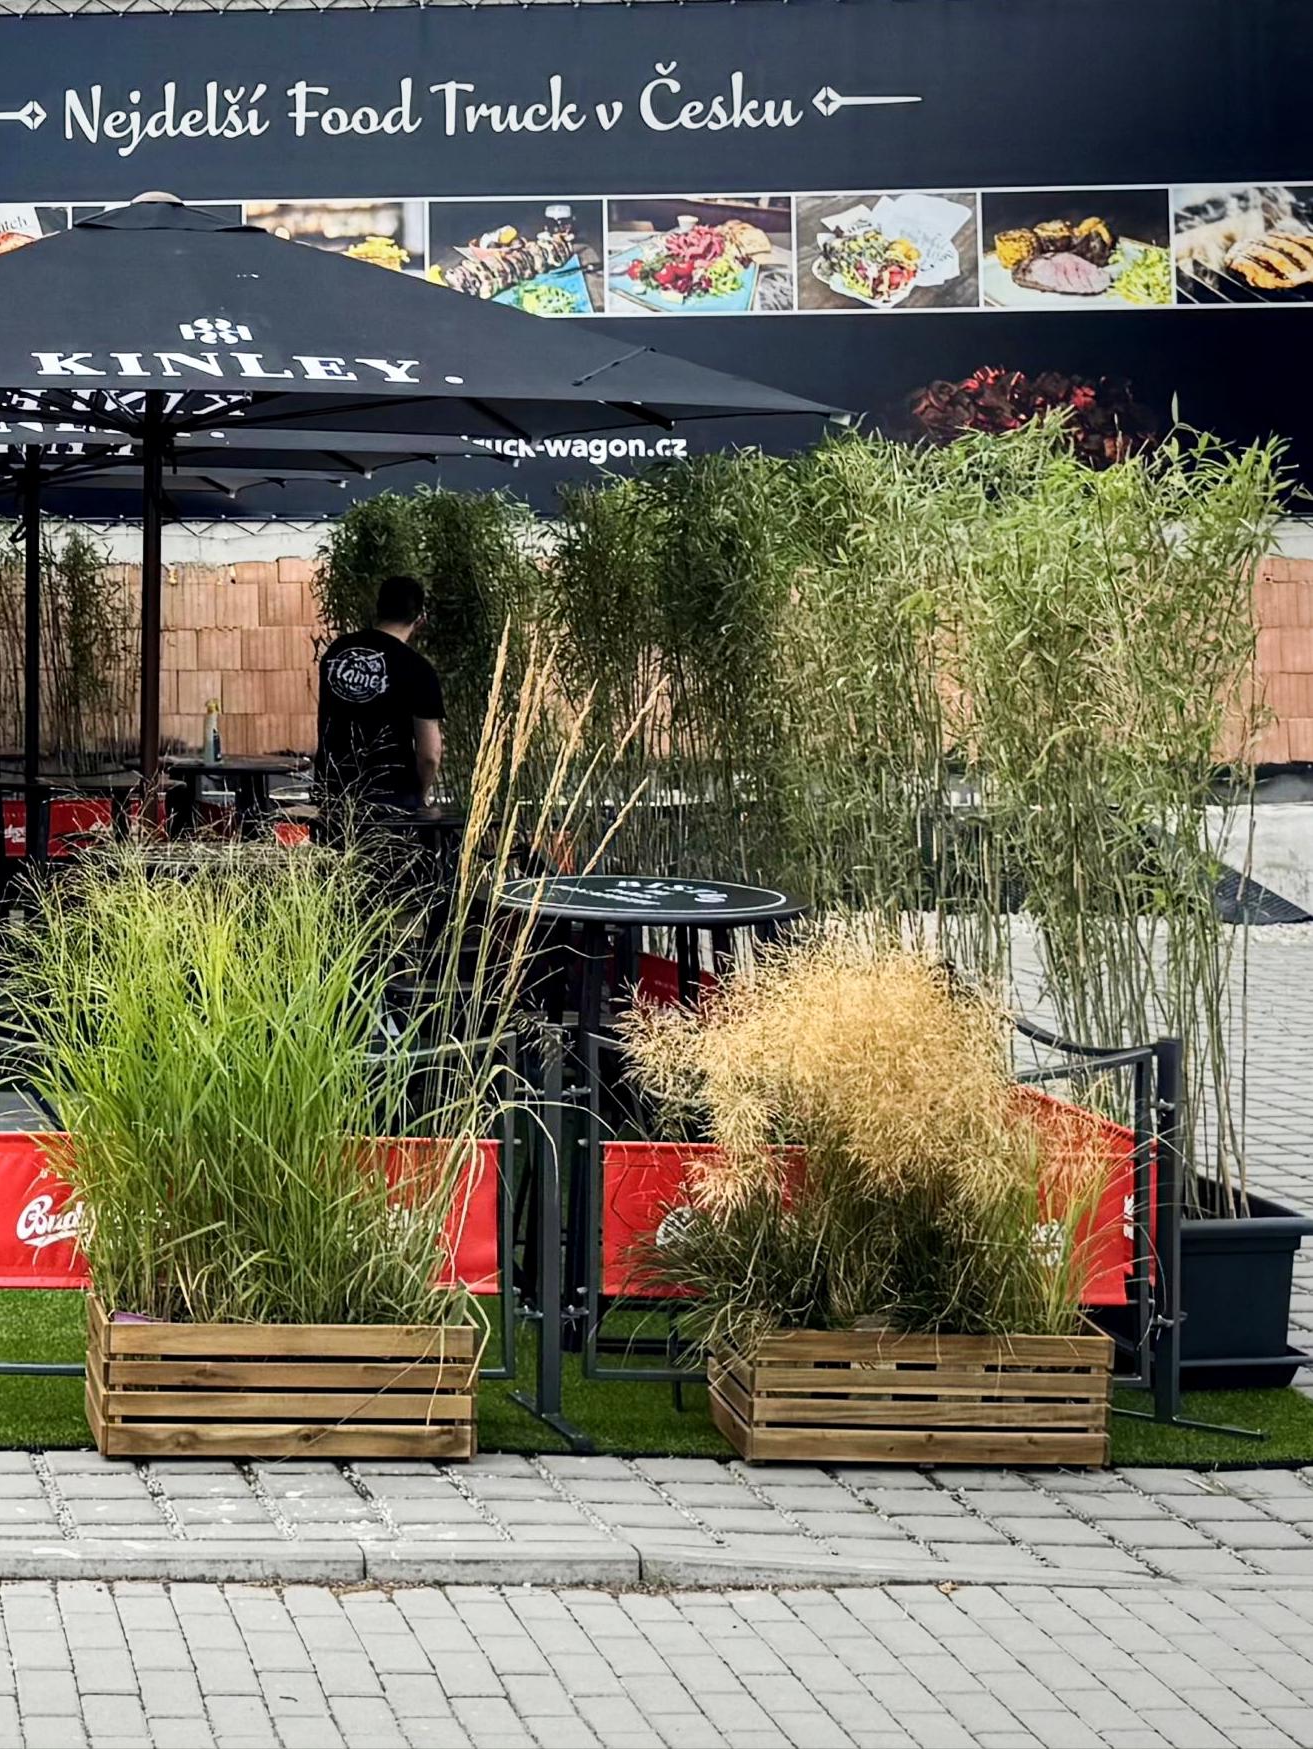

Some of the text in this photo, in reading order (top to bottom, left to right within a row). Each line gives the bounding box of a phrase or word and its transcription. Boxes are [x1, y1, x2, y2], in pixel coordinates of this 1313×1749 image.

[64, 60, 803, 157] Nejdelší Food Truck v Česku
